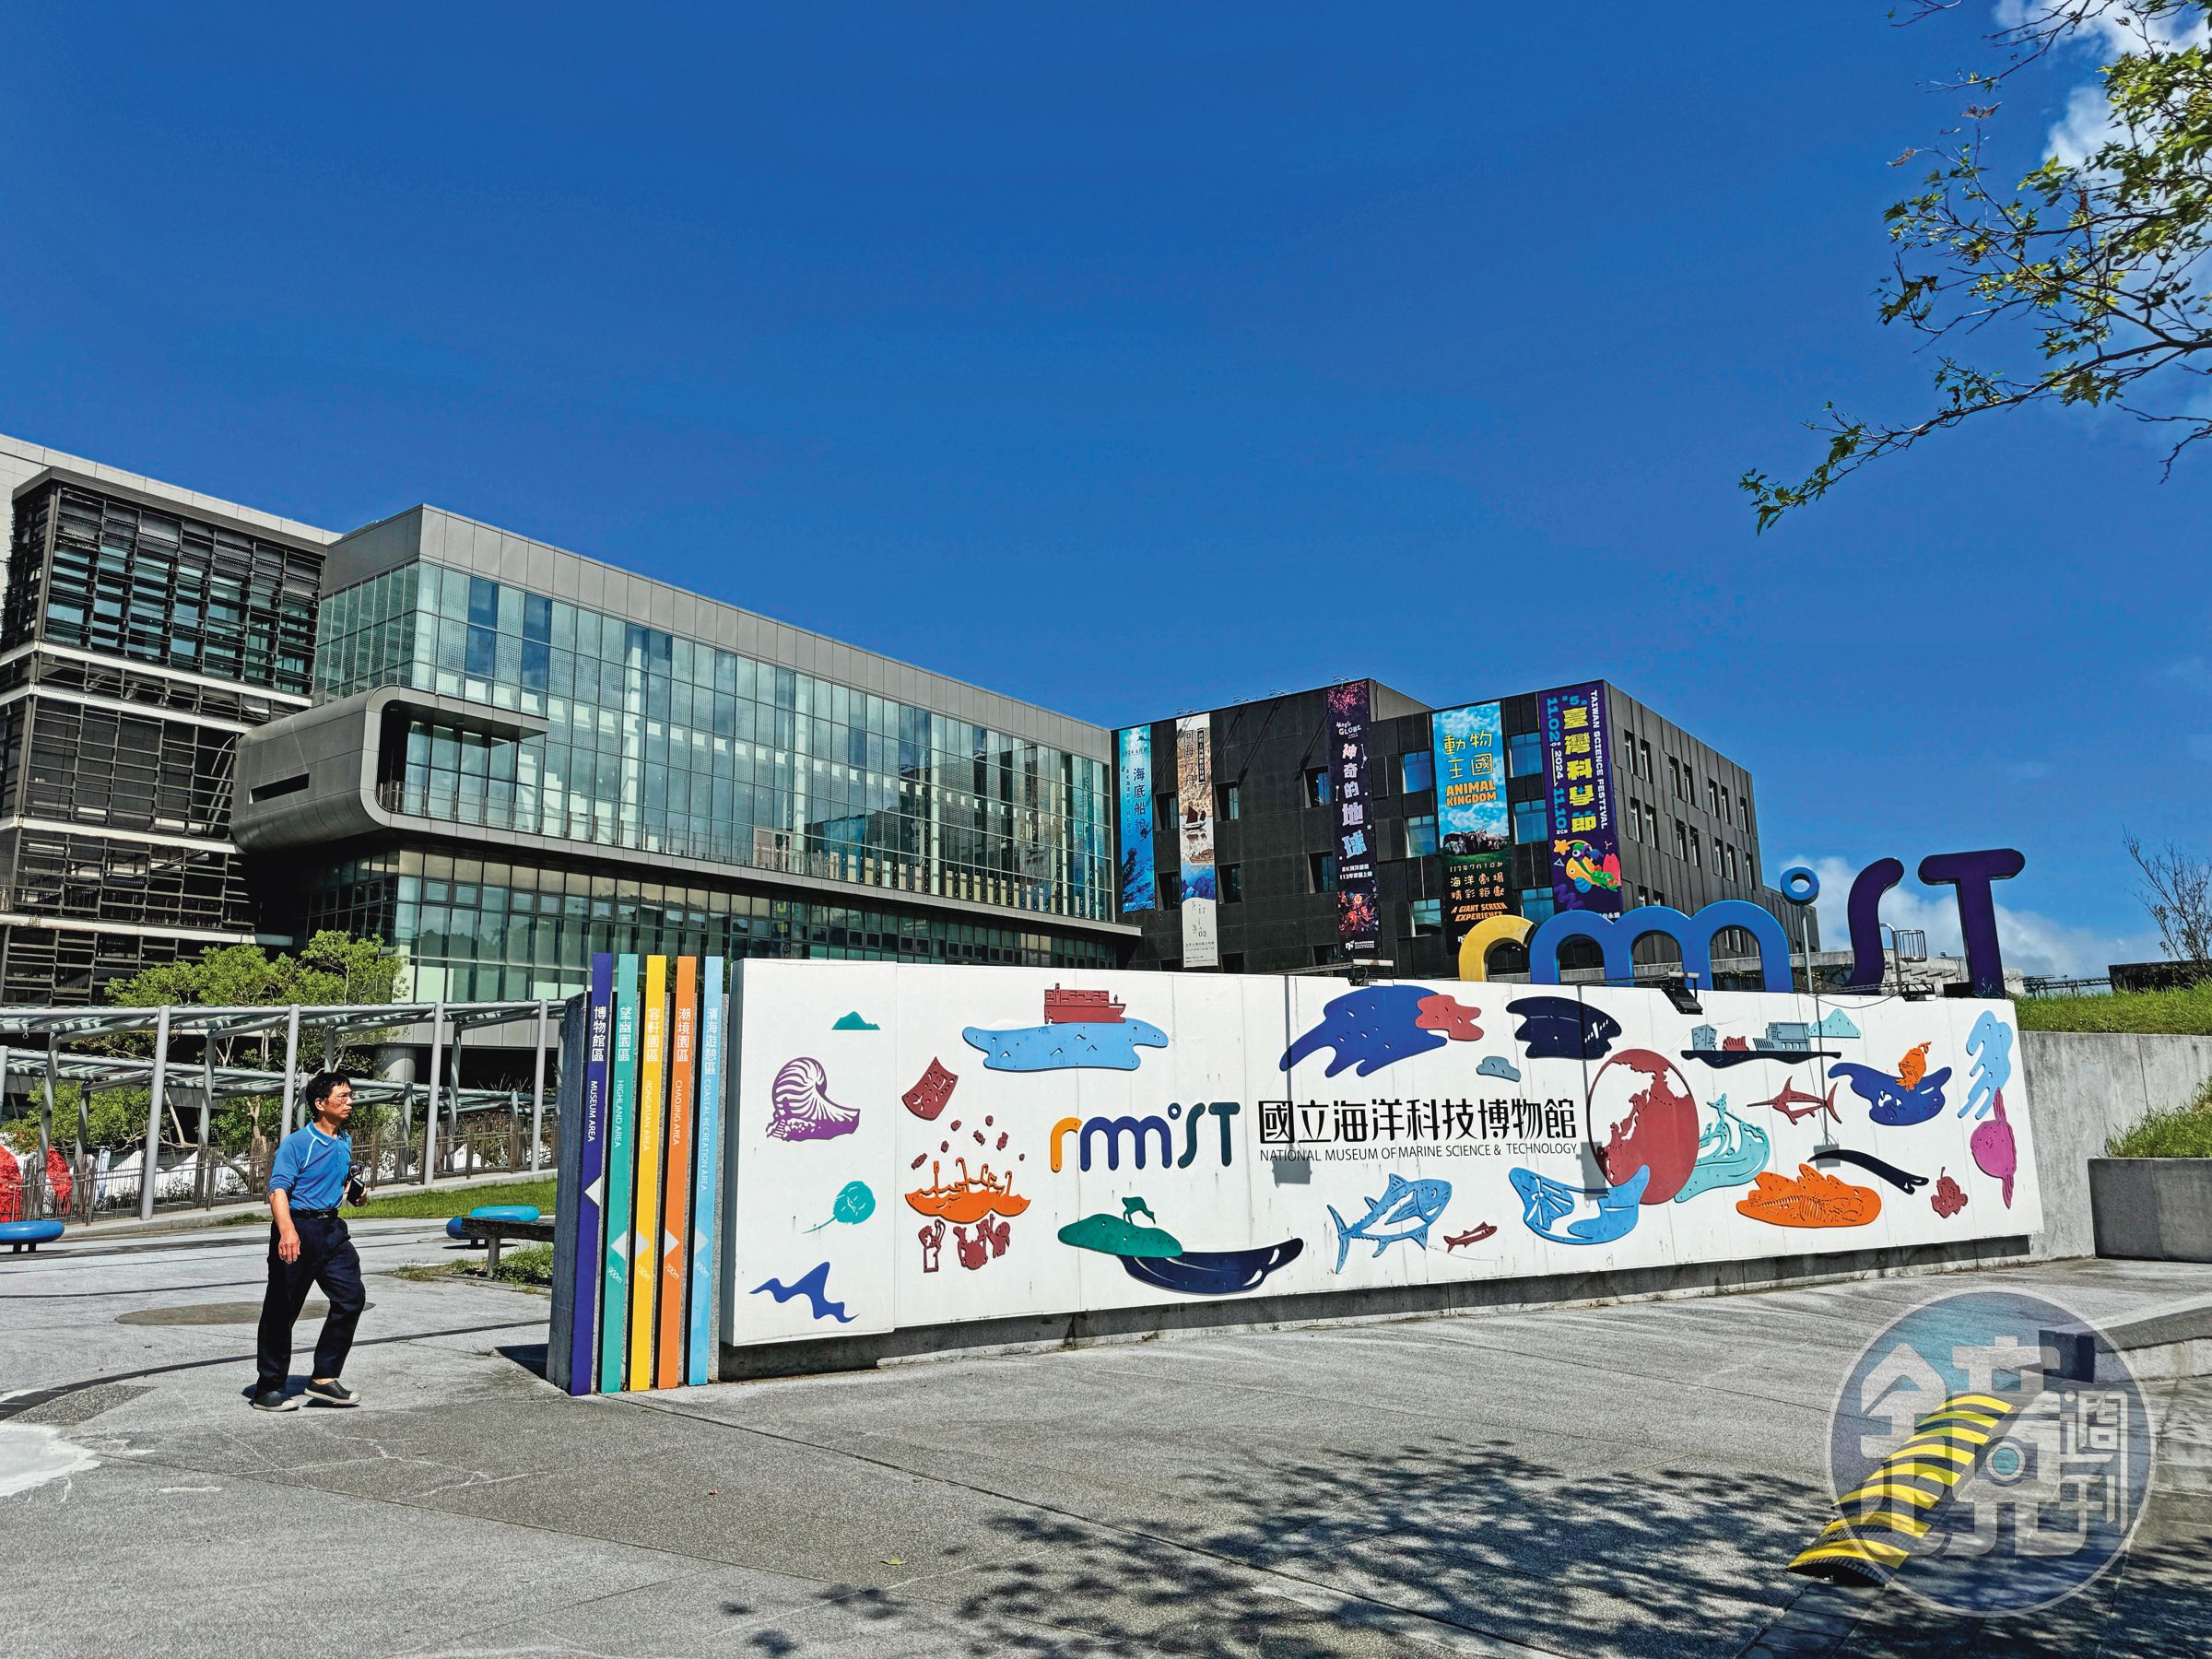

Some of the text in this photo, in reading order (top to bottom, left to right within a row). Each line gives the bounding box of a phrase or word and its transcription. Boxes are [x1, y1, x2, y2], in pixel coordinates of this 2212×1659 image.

[1338, 724, 1362, 735] GLOBE
[1547, 697, 1560, 742] 11.02
[1443, 729, 1492, 755] 動物
[1591, 689, 1608, 830] TAIWAN SCIENCE FESTIVAL
[1447, 753, 1493, 779] 王國
[1555, 749, 1564, 780] 2024
[1342, 743, 1368, 859] 神奇的地球
[1446, 779, 1496, 797] ANIMAL
[1446, 791, 1497, 807] KINGDOM
[1553, 787, 1568, 830] 11.10
[1450, 871, 1504, 888] 海洋劇場
[1458, 904, 1479, 913] GIANT
[1481, 901, 1508, 912] SCREEN
[592, 1006, 607, 1062] 博物館區
[677, 1007, 691, 1062] 潮境園區
[587, 1080, 598, 1142] MUSEUM AREA
[614, 1079, 624, 1148] HIGHLAND AREA
[673, 1079, 683, 1146] CHAOJING AREA
[703, 1078, 712, 1117] COASTAL
[1258, 1097, 1577, 1144] 國立海洋科技博物館
[642, 1128, 652, 1151] AREA
[701, 1118, 711, 1168] RECREATION
[1260, 1142, 1578, 1162] NATIONAL MUSEUM OF MARINE SCIENCE & TECHNOLOGY
[607, 1266, 623, 1284] 900m
[664, 1263, 680, 1280] 700m
